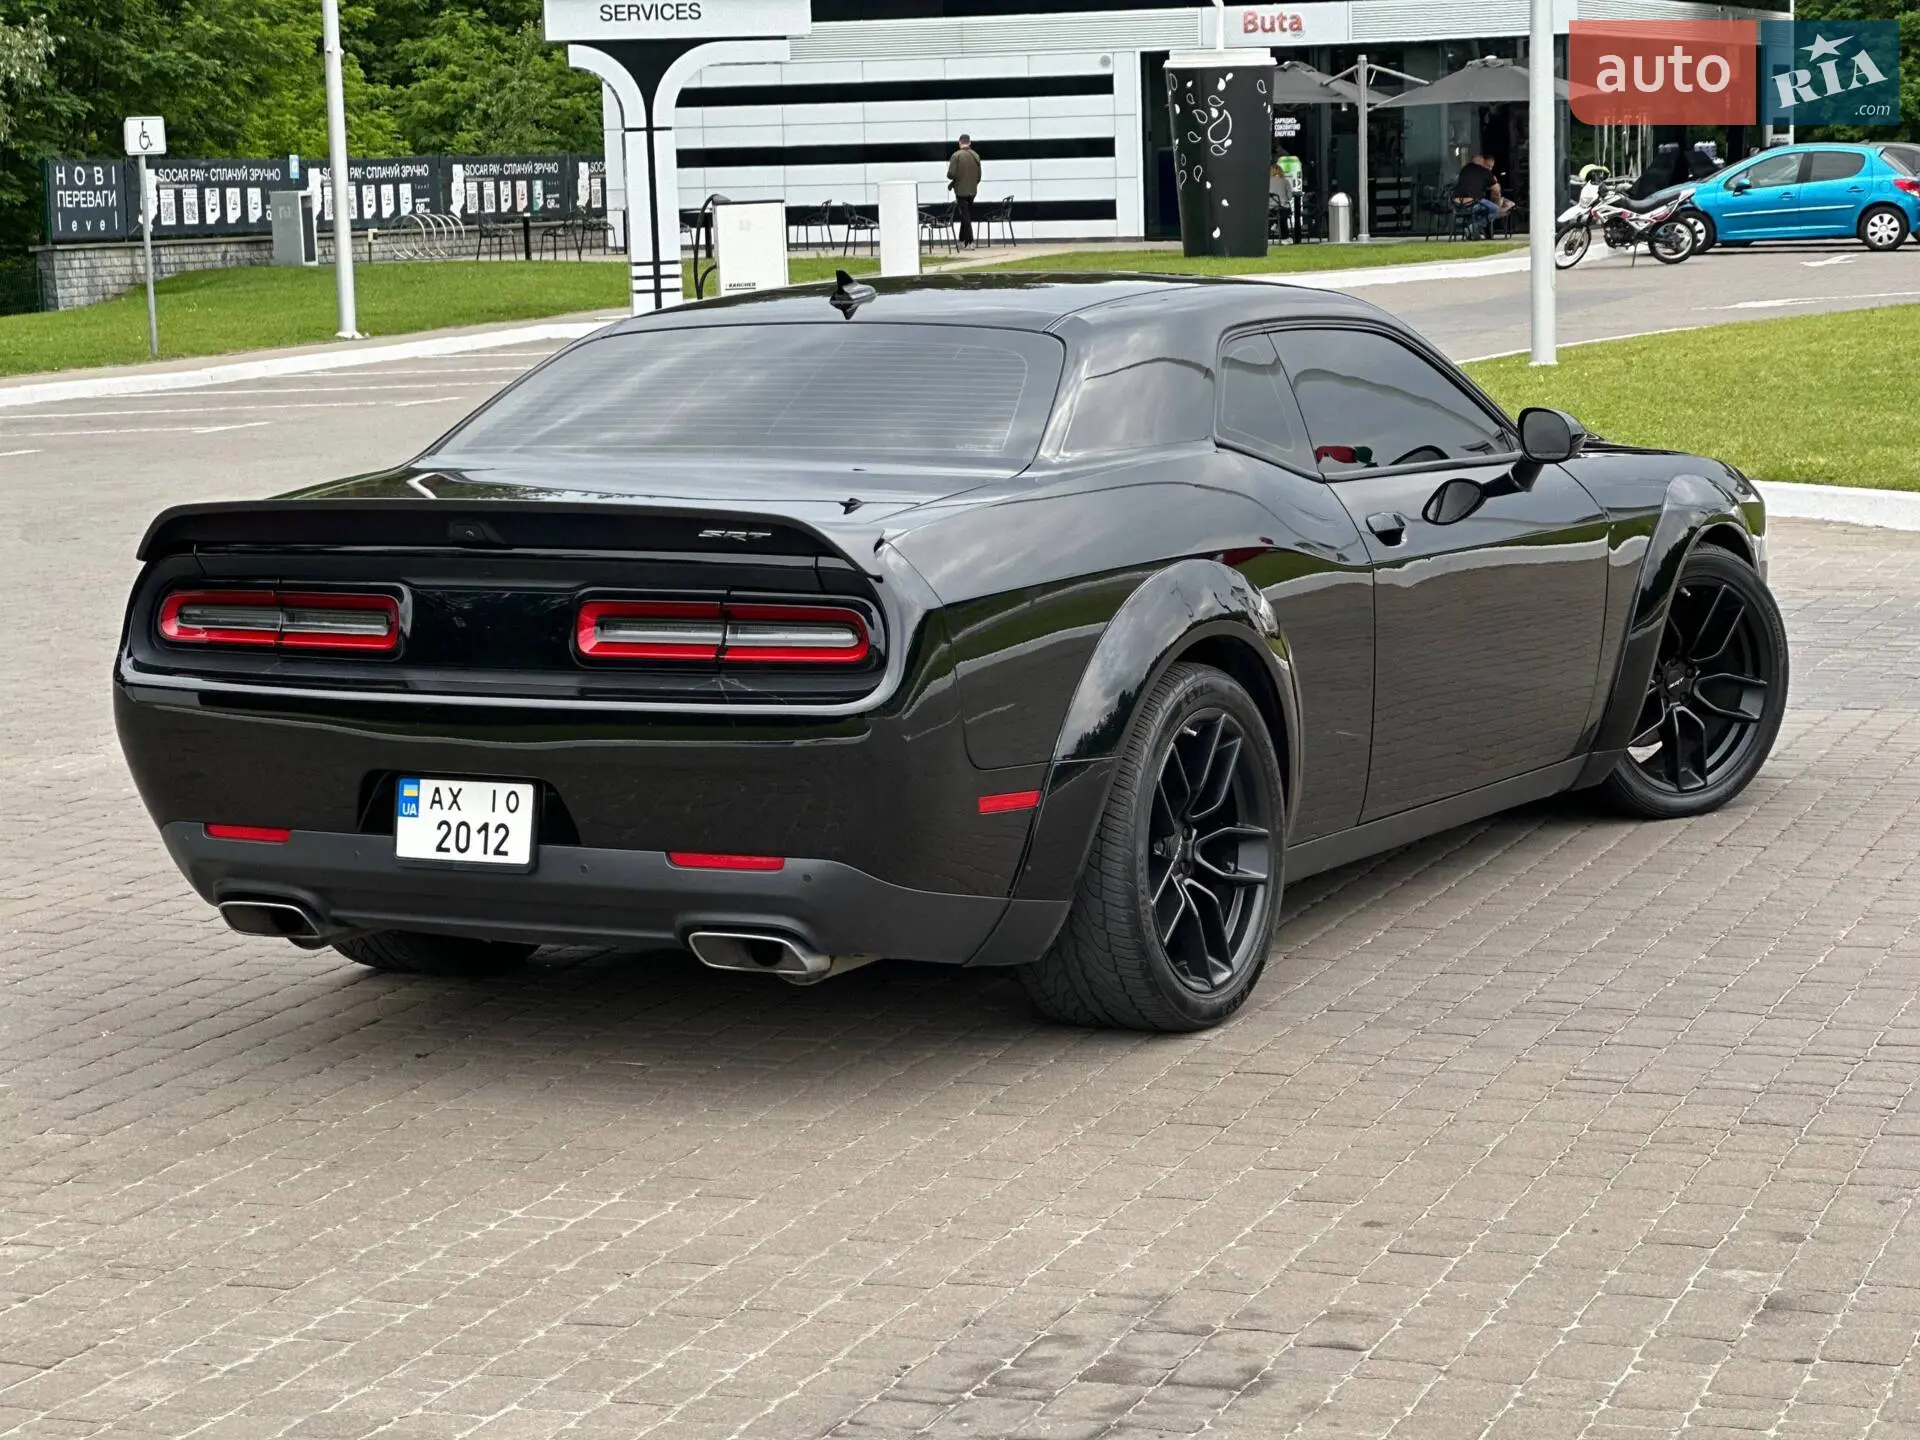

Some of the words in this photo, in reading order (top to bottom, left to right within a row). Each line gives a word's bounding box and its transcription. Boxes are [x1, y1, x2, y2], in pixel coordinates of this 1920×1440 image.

[599, 2, 702, 22] SERVICES
[1243, 10, 1303, 33] Buta
[56, 165, 116, 186] НОВІ
[158, 168, 189, 181] SOCAR
[209, 165, 248, 181] СПЛАЧУЙ
[249, 167, 281, 181] ЗРУЧНО
[366, 163, 400, 179] СПЛАЧУЙ
[400, 164, 429, 178] ЗРУЧНО
[464, 163, 489, 175] SOCAR
[503, 160, 533, 175] СПЛАЧУЙ
[533, 162, 559, 174] ЗРУЧНО
[57, 189, 117, 208] ПЕРЕВАГИ
[58, 210, 118, 232] level
[402, 802, 417, 815] UA
[429, 786, 463, 811] AX
[435, 819, 510, 857] 2012
